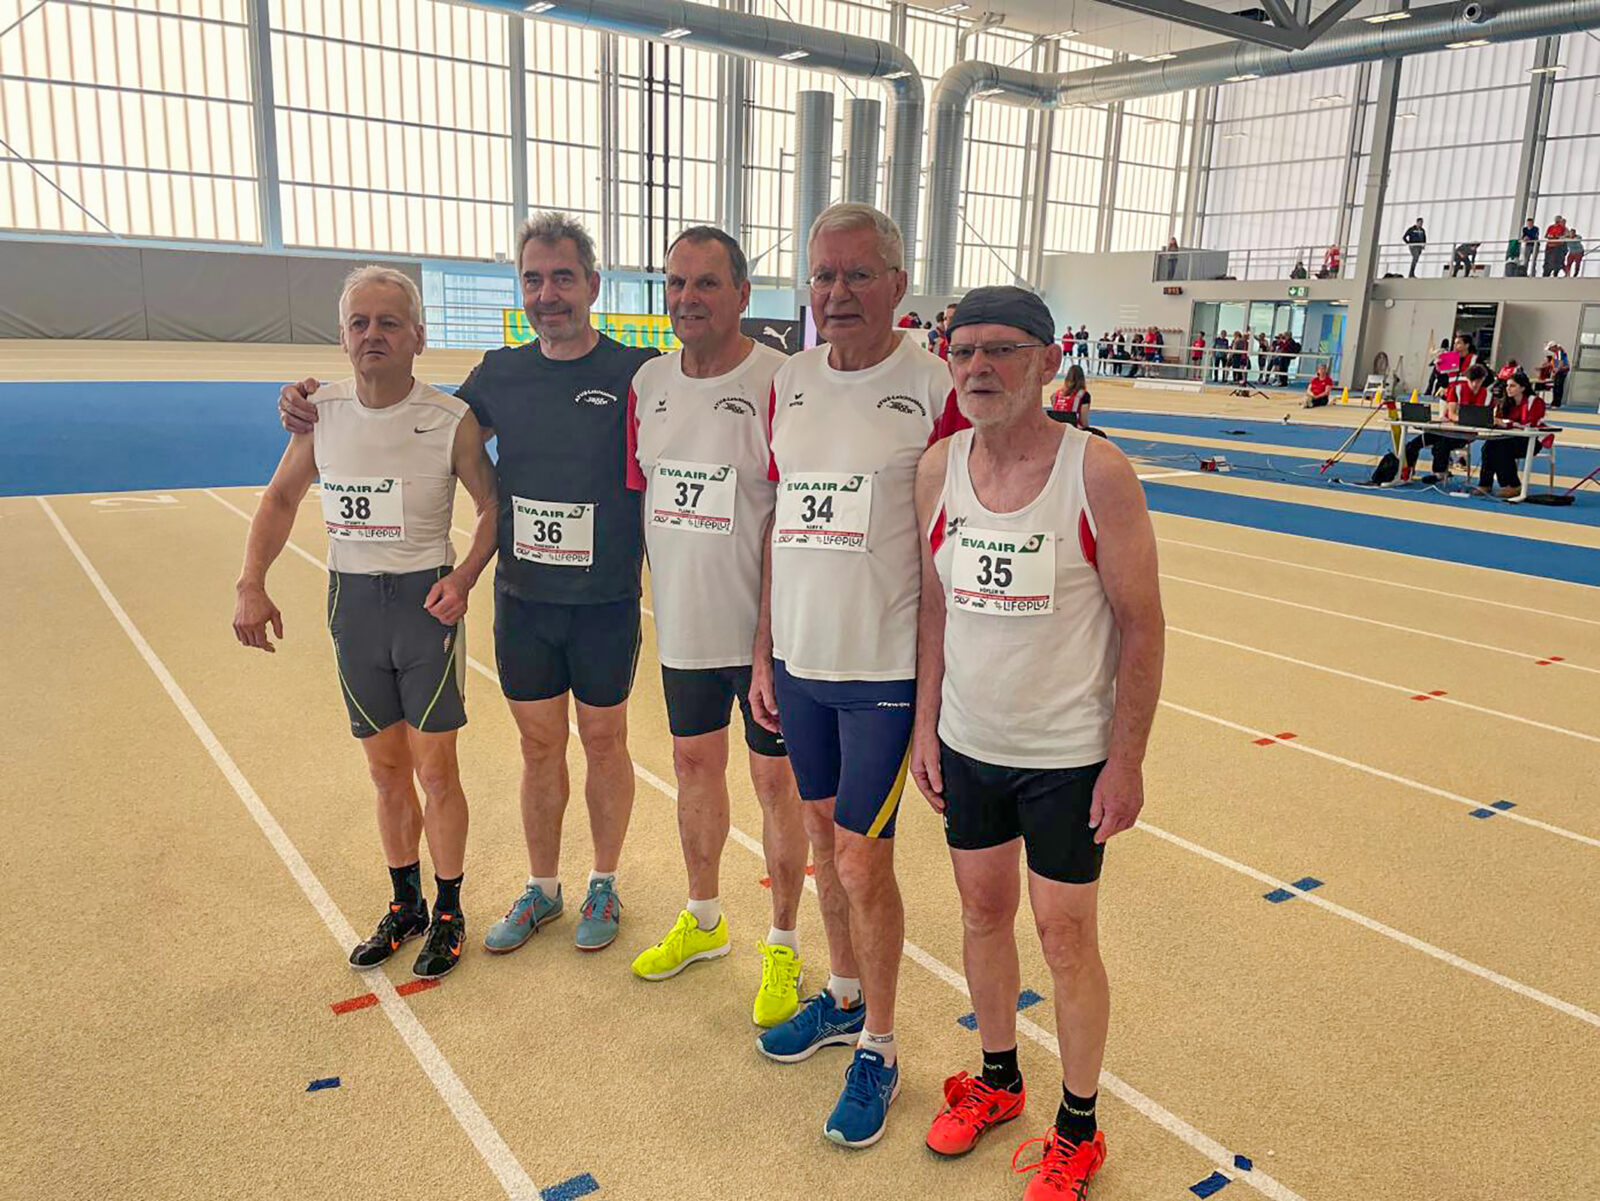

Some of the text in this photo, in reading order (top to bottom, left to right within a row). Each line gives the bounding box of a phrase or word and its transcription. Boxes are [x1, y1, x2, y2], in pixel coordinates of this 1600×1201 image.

[339, 496, 371, 519] 38
[674, 482, 704, 508] 37
[801, 495, 833, 523] 34
[533, 520, 562, 543] 36
[976, 555, 1013, 588] 35
